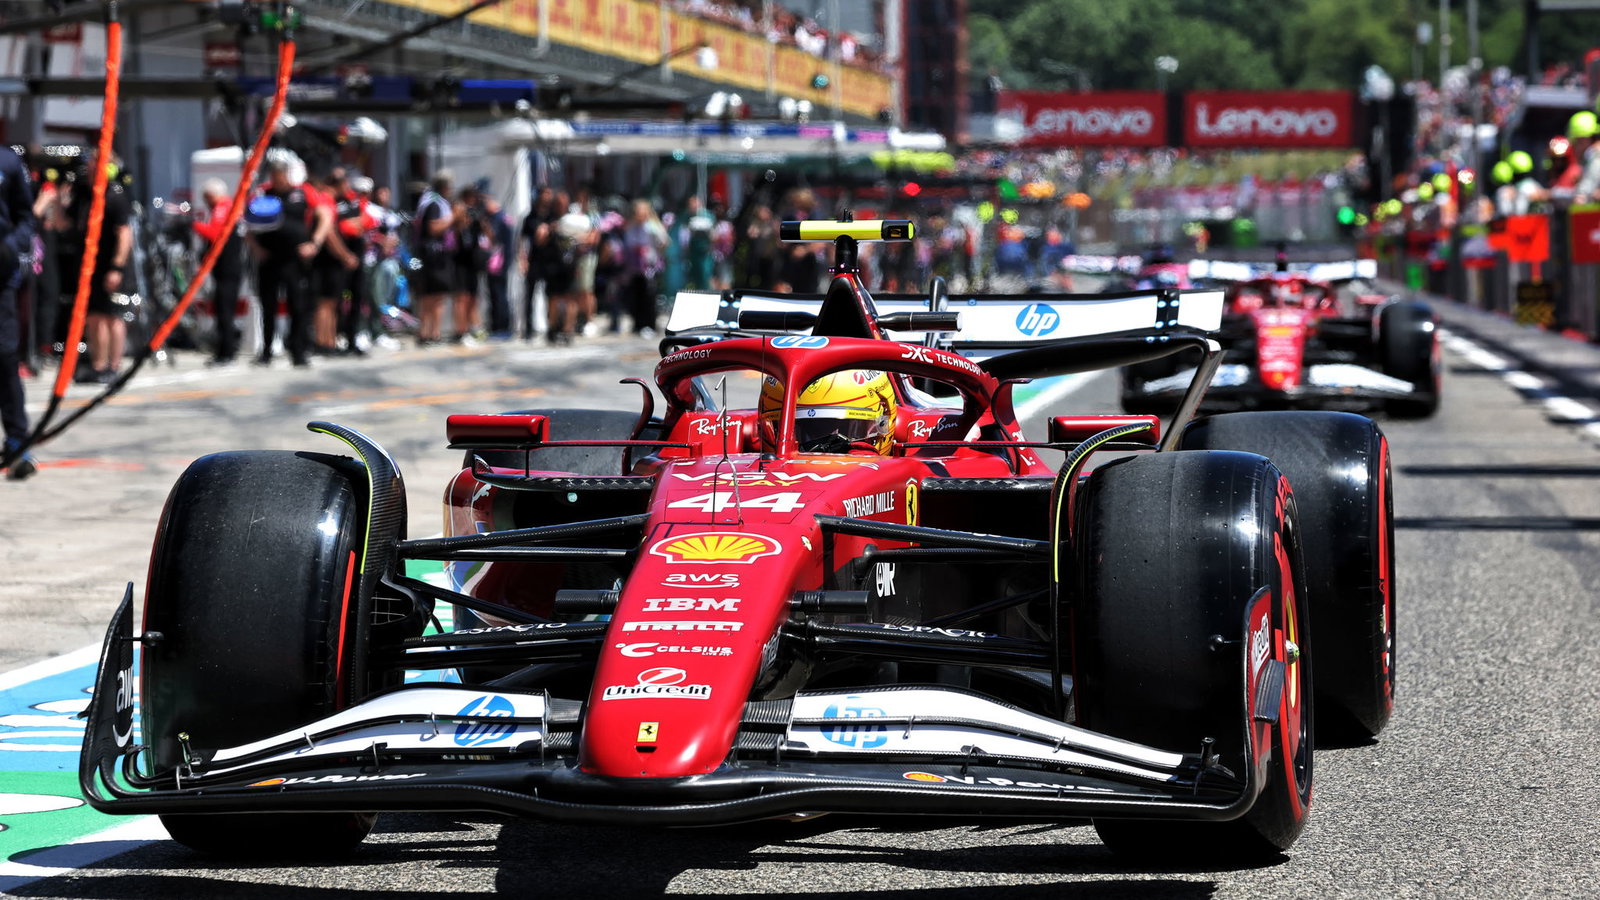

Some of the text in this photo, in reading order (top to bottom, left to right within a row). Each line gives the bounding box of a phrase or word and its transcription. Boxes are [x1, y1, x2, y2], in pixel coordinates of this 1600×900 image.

[1016, 102, 1154, 136] Lenovo
[1195, 102, 1337, 137] Lenovo
[1019, 304, 1057, 337] hp
[664, 349, 712, 363] TECHNOLOGY
[899, 344, 983, 376] DXC TECHNOLOGY
[907, 418, 959, 437] Ray-Ban
[671, 471, 847, 482] VGW
[667, 491, 806, 513] 44
[842, 491, 895, 518] RICHARD MILLE
[665, 573, 739, 583] aws
[642, 598, 742, 611] IBM
[622, 620, 744, 631] PIRELLI
[656, 646, 733, 654] CELSIUS
[606, 685, 709, 697] UniCredit
[458, 695, 513, 746] hp
[832, 697, 885, 748] hp
[282, 773, 427, 785] V-Power
[943, 775, 1115, 792] V-Power
